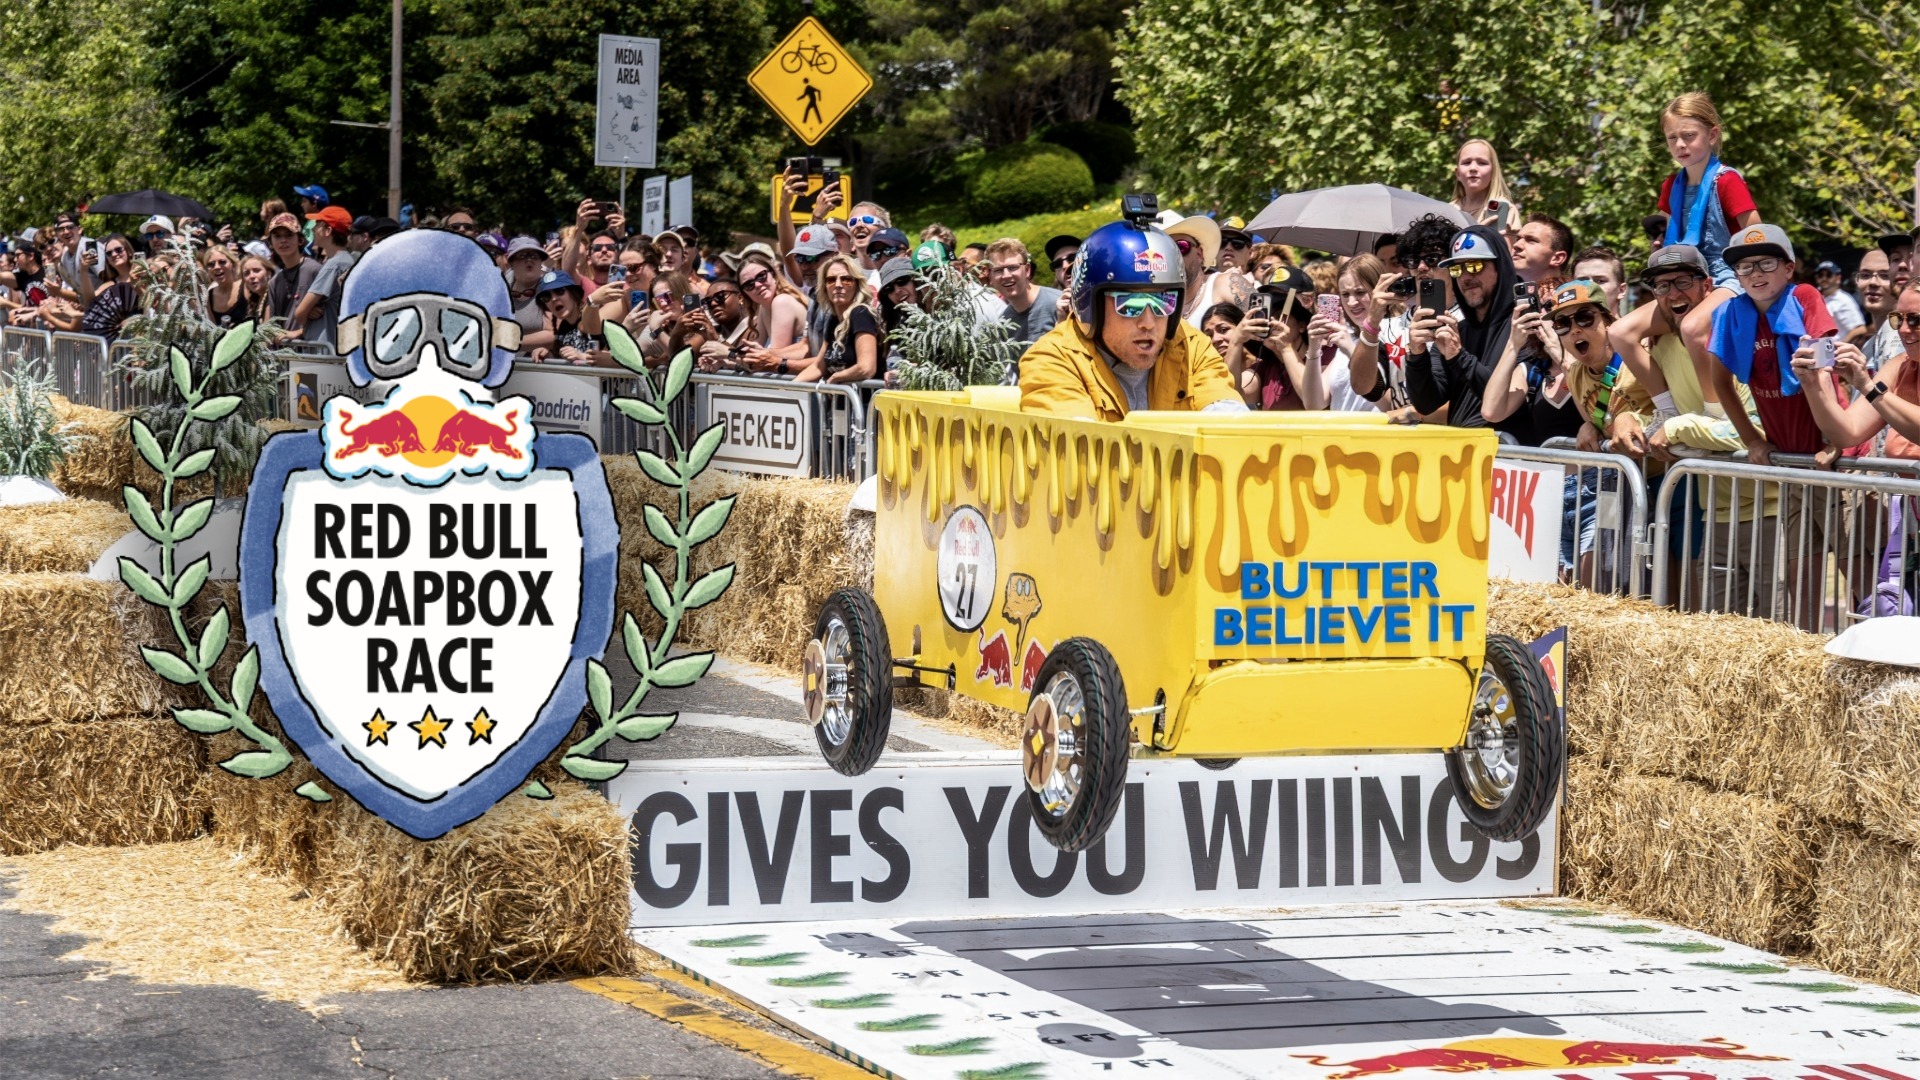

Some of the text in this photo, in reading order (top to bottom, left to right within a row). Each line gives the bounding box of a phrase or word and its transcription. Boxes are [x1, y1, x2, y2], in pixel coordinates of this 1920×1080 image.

[615, 48, 643, 66] MEDIA
[616, 68, 640, 85] AREA
[1135, 263, 1151, 271] Red
[320, 383, 345, 396] UTAH
[529, 395, 591, 421] oodrich
[718, 411, 797, 450] DECKED
[1240, 561, 1440, 600] BUTTER
[955, 562, 978, 619] 27
[1214, 605, 1475, 646] BELIEVE IT
[631, 786, 911, 909] GIVES
[942, 783, 1146, 898] YOU
[1573, 945, 1613, 953] FT
[892, 969, 965, 980] 3 FT
[1635, 967, 1675, 975] FT
[1700, 985, 1742, 993] FT
[988, 1010, 1063, 1021] 5 FT
[1741, 1005, 1815, 1014] 6 FT
[1041, 1032, 1118, 1045] 6 FT
[1809, 1028, 1888, 1039] 7 FT
[1092, 1058, 1175, 1071] 7 FT
